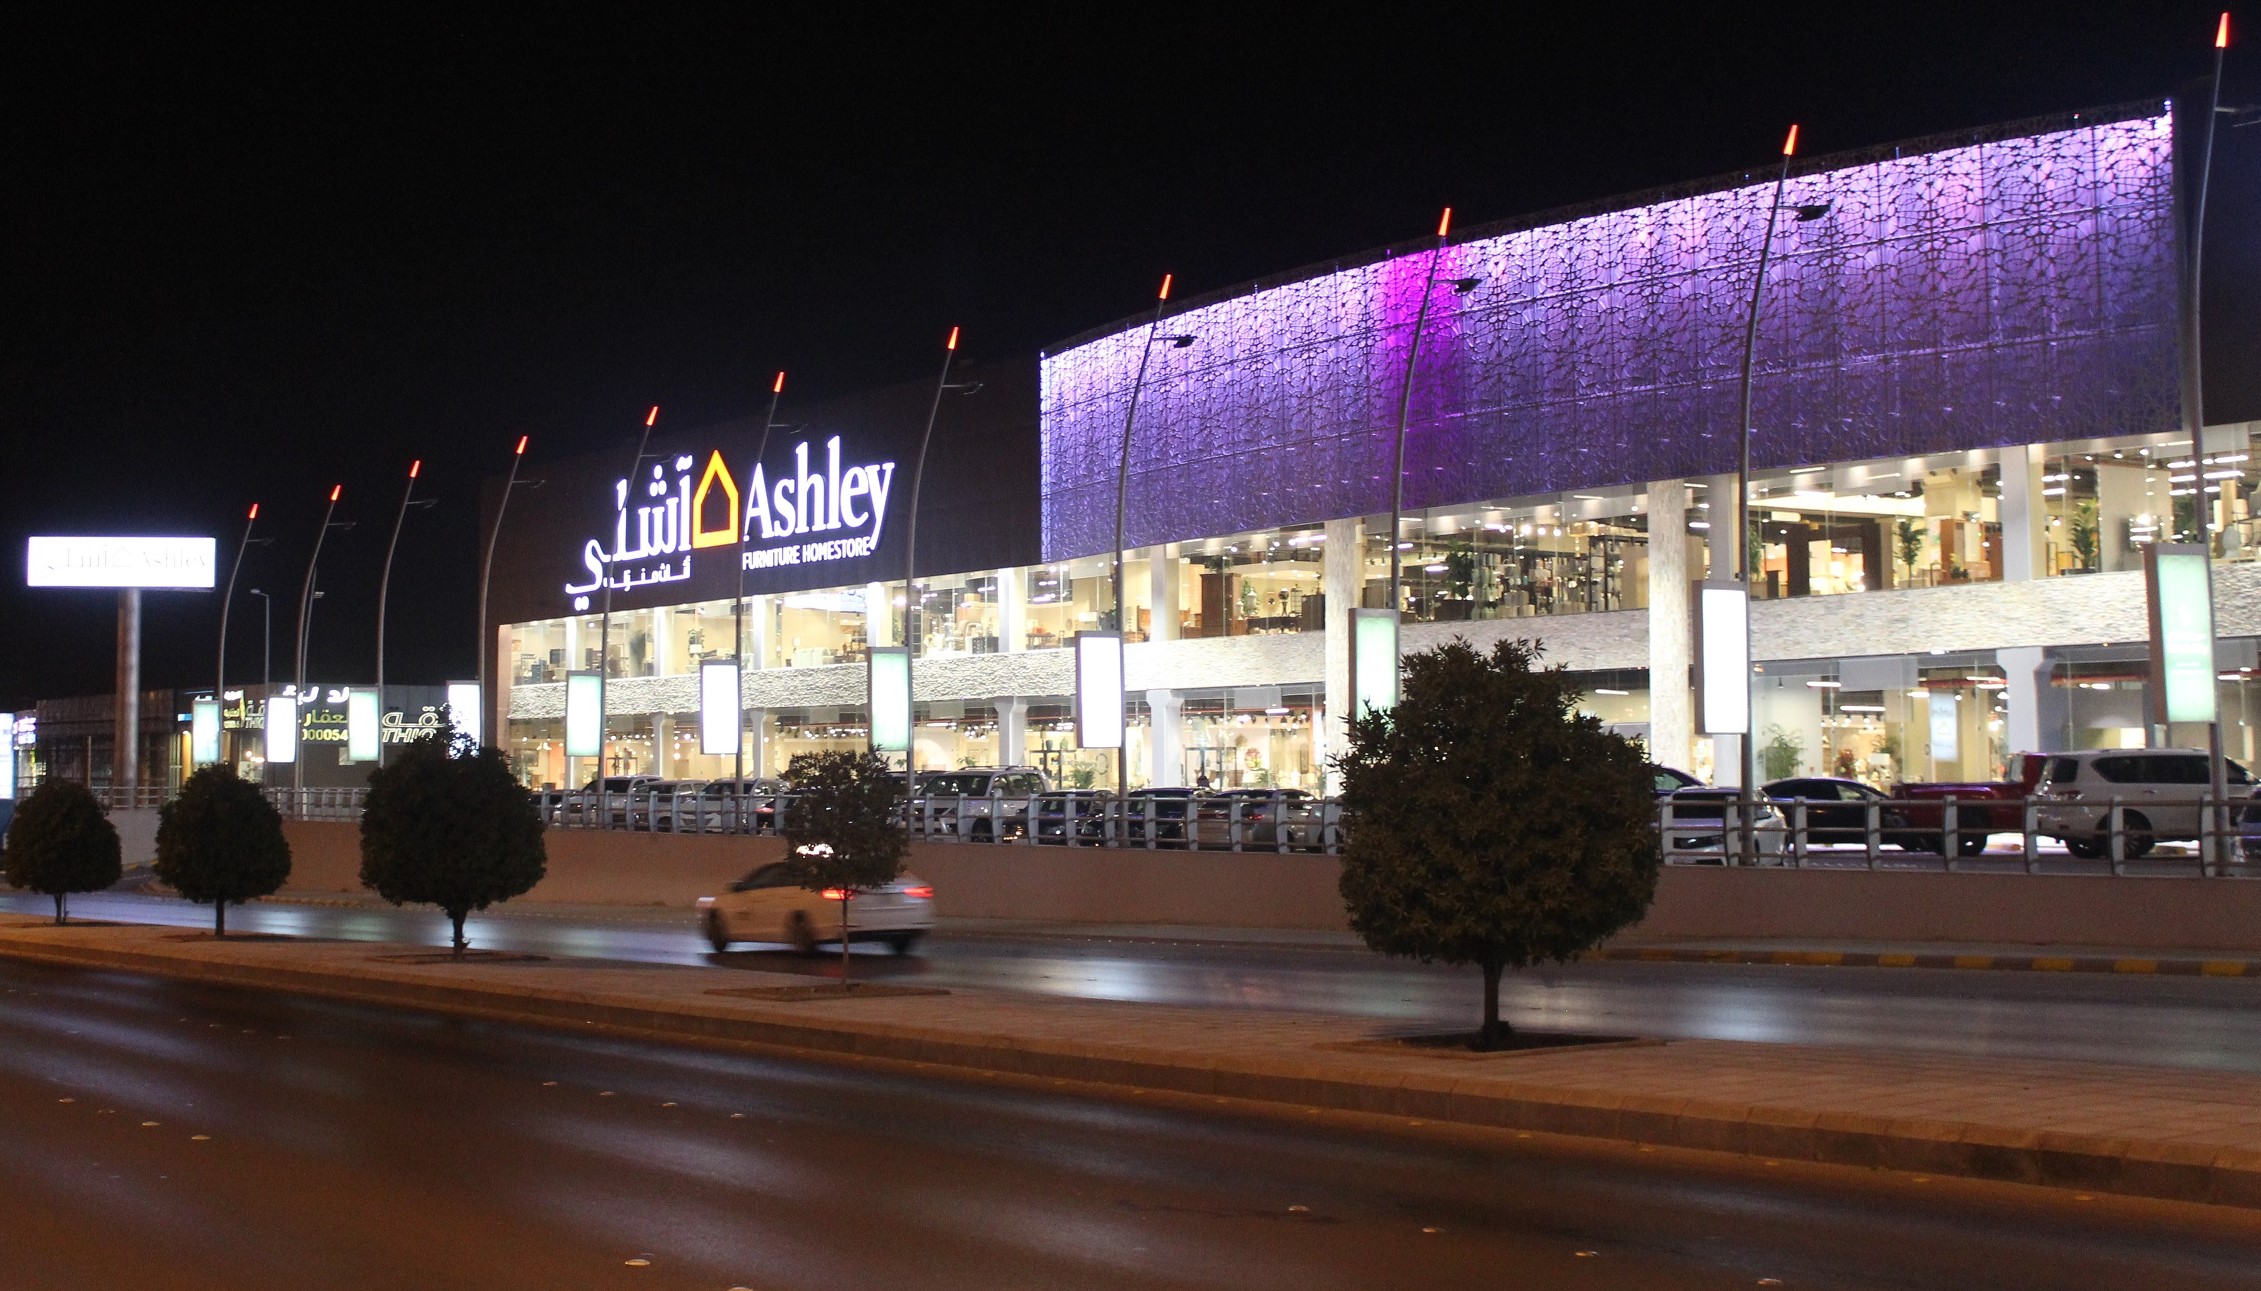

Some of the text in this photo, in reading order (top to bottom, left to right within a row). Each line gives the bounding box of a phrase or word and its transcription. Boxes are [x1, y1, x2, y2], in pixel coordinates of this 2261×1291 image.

[742, 435, 896, 550] Ashley
[742, 536, 871, 571] FURNITURE HOMESTORE
